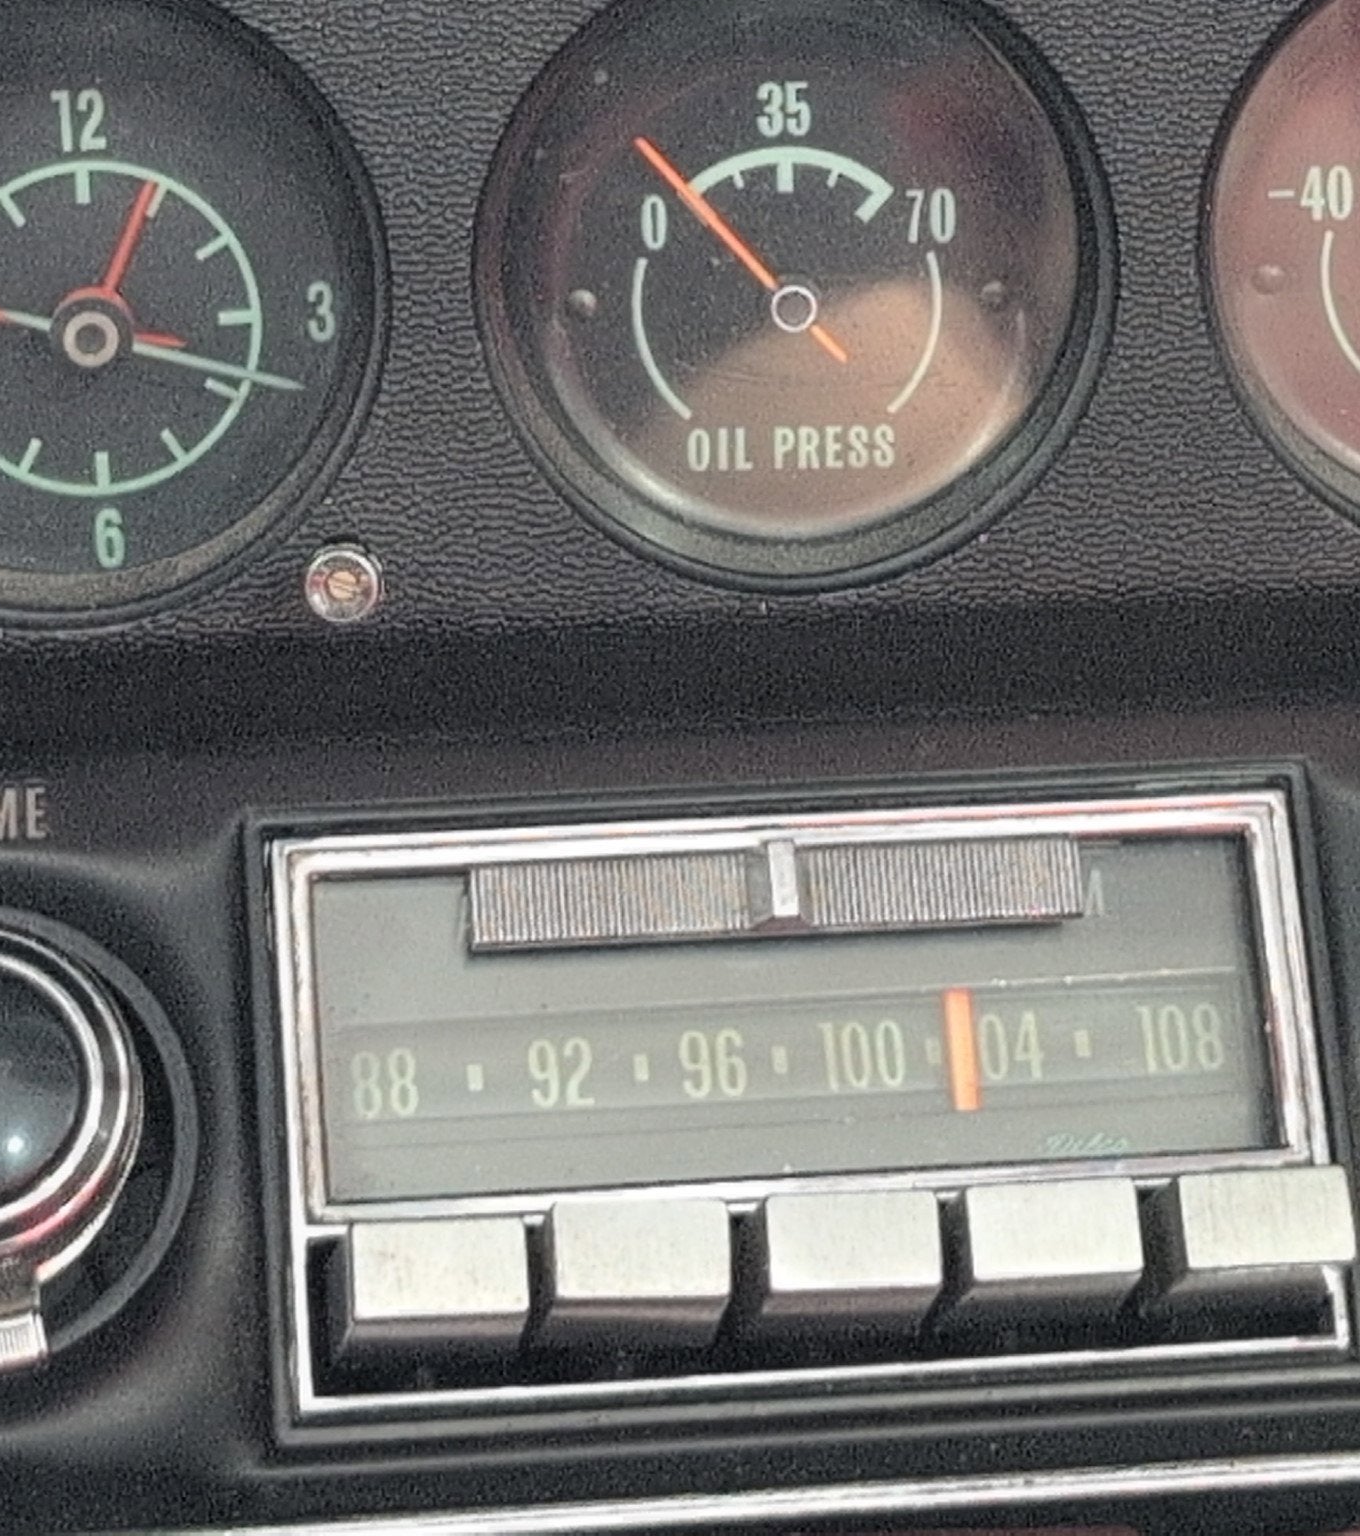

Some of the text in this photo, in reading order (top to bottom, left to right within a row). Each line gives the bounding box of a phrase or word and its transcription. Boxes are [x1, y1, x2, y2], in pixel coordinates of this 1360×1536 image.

[50, 88, 107, 152] 12
[756, 81, 811, 137] 35
[906, 187, 956, 243] 70
[1268, 164, 1353, 221] -40
[641, 195, 668, 250] 0
[307, 281, 336, 342] 3
[687, 424, 895, 472] OIL PRESS
[95, 508, 125, 567] 6
[351, 1002, 1225, 1119] 88 92 96 100 04 108
